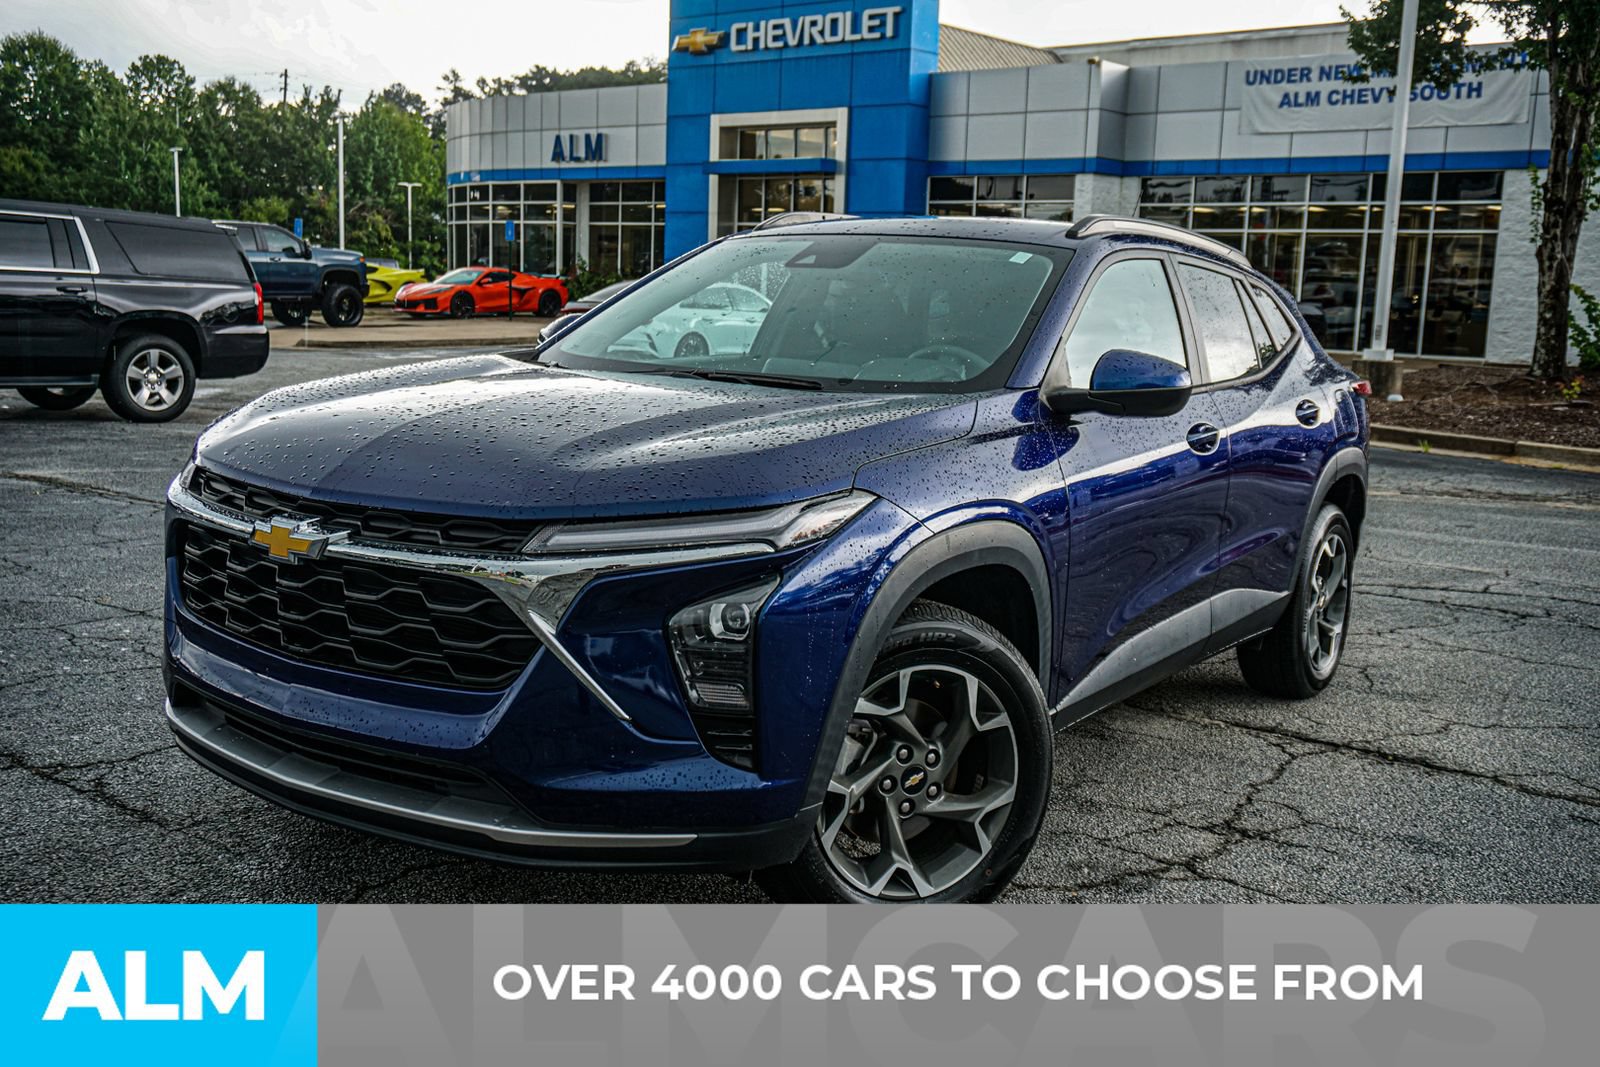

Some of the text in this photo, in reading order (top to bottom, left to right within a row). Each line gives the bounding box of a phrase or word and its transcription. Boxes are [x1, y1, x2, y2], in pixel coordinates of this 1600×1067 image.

[730, 6, 902, 51] CHEVROLET
[1245, 65, 1313, 86] UNDER
[1278, 89, 1321, 109] ALM
[551, 132, 604, 163] ALM
